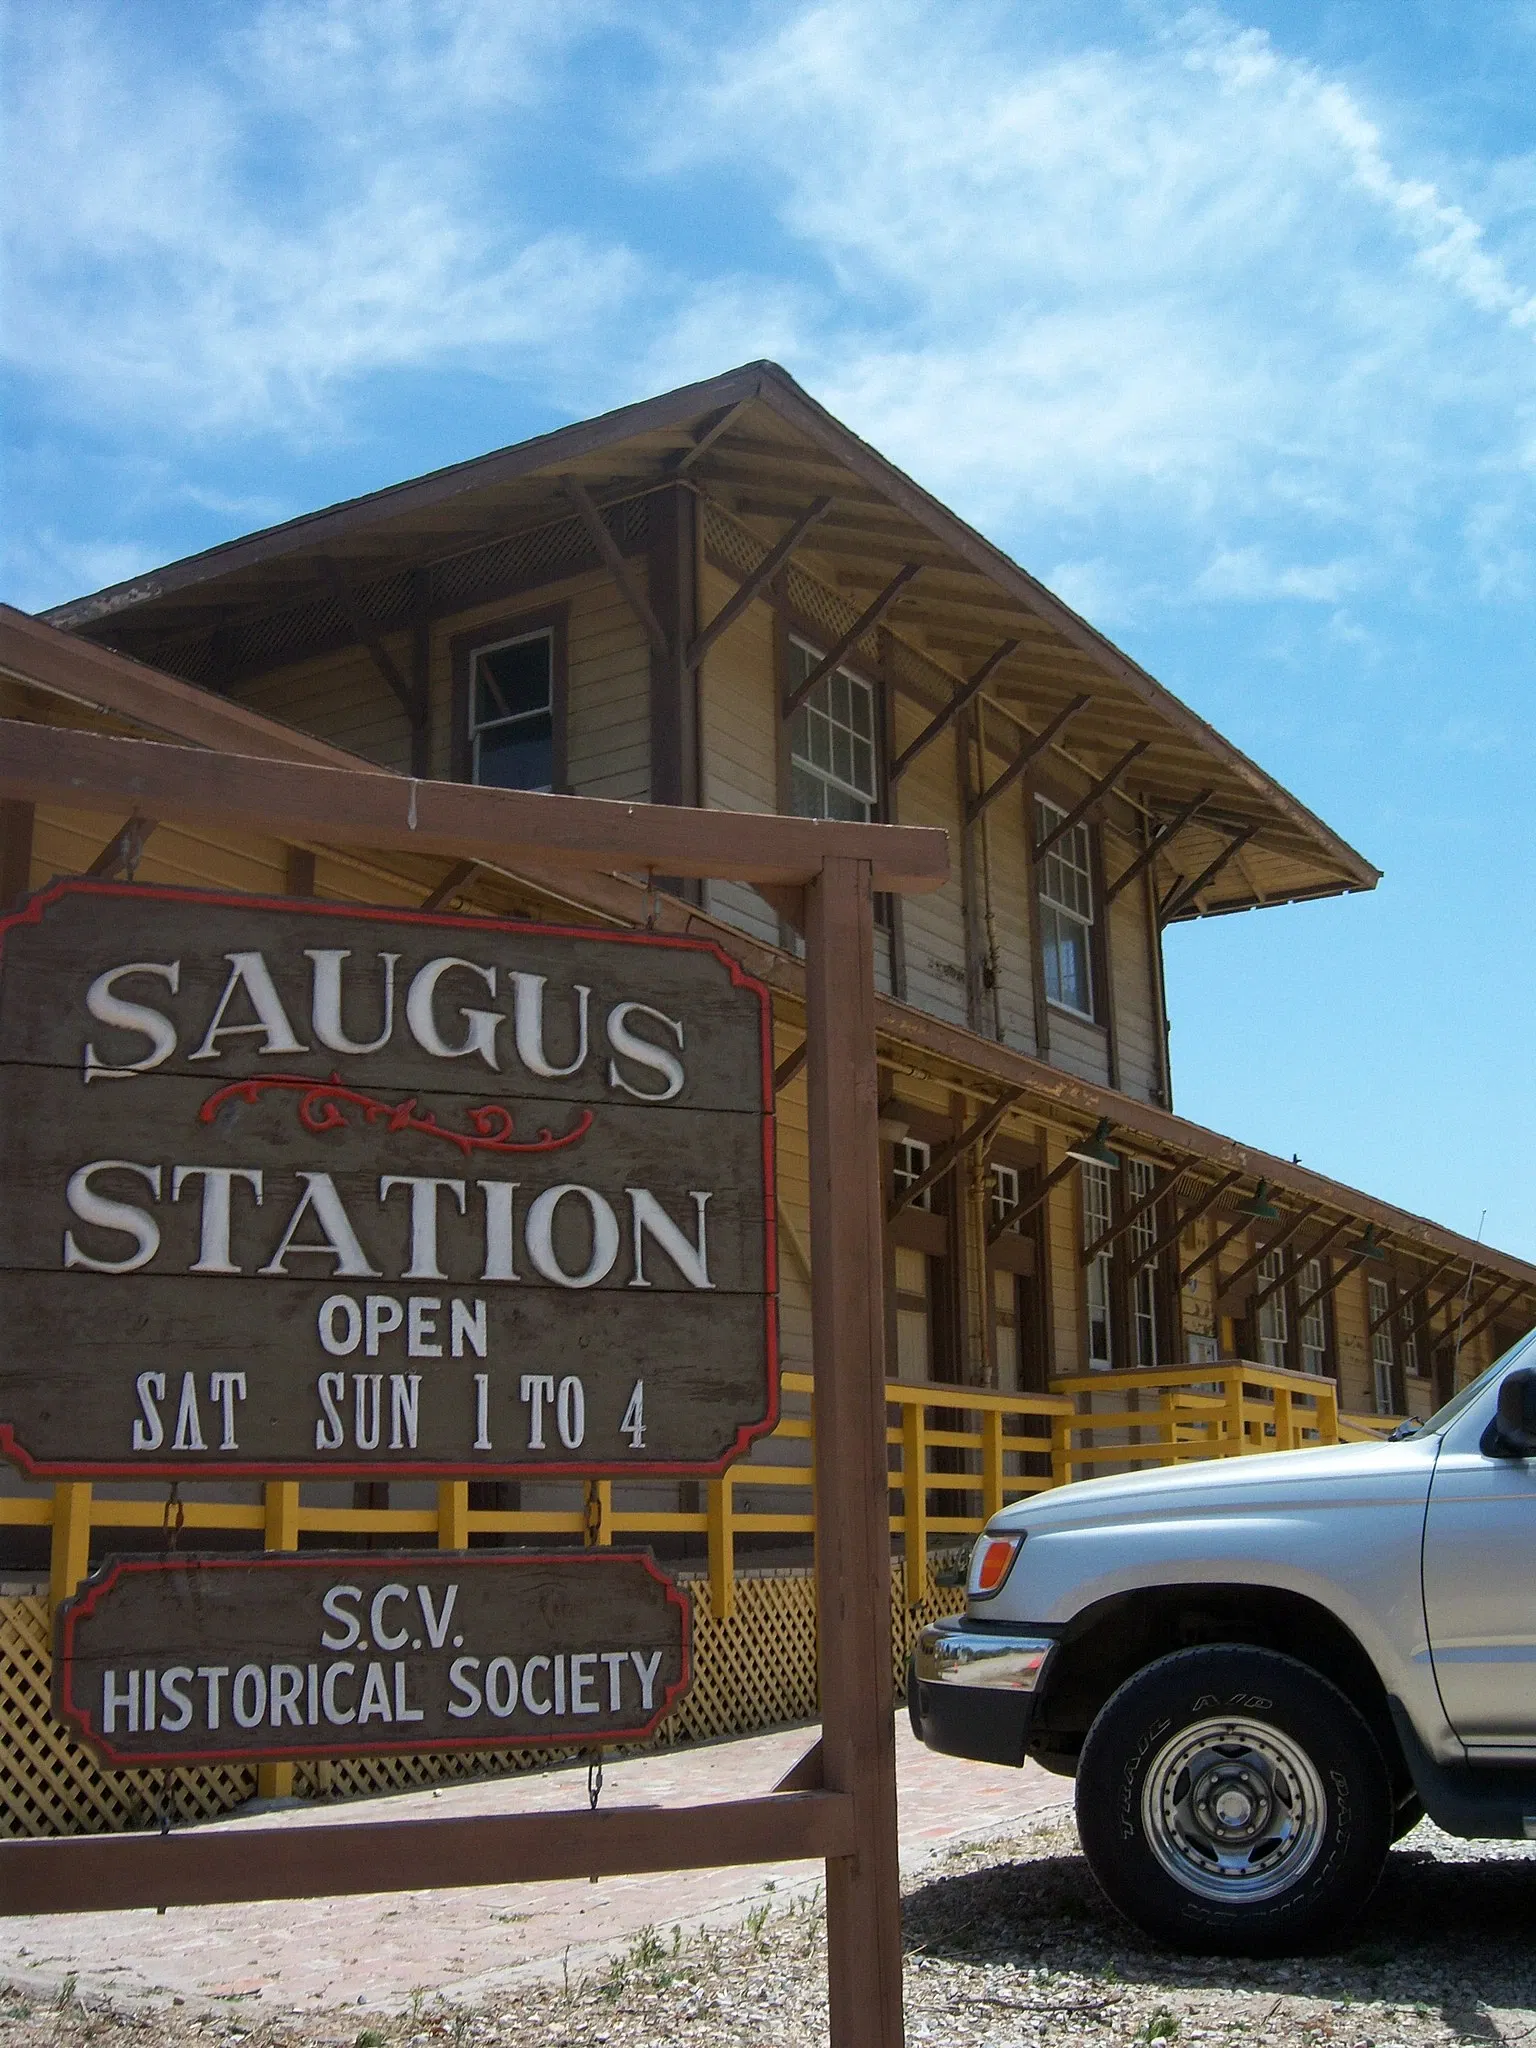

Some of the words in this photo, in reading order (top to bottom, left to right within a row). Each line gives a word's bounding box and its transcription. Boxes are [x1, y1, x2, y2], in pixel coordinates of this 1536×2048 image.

[85, 949, 684, 1101] SAUGUS
[65, 1160, 716, 1289] STATION
[318, 1294, 488, 1358] OPEN
[133, 1371, 247, 1451] SAT
[316, 1371, 423, 1450] SUN
[473, 1373, 493, 1450] 1
[520, 1374, 585, 1449] TO
[620, 1379, 647, 1449] 4
[321, 1583, 464, 1651] S.C.V.
[103, 1661, 424, 1733] HISTORICAL
[447, 1651, 663, 1718] SOCIETY
